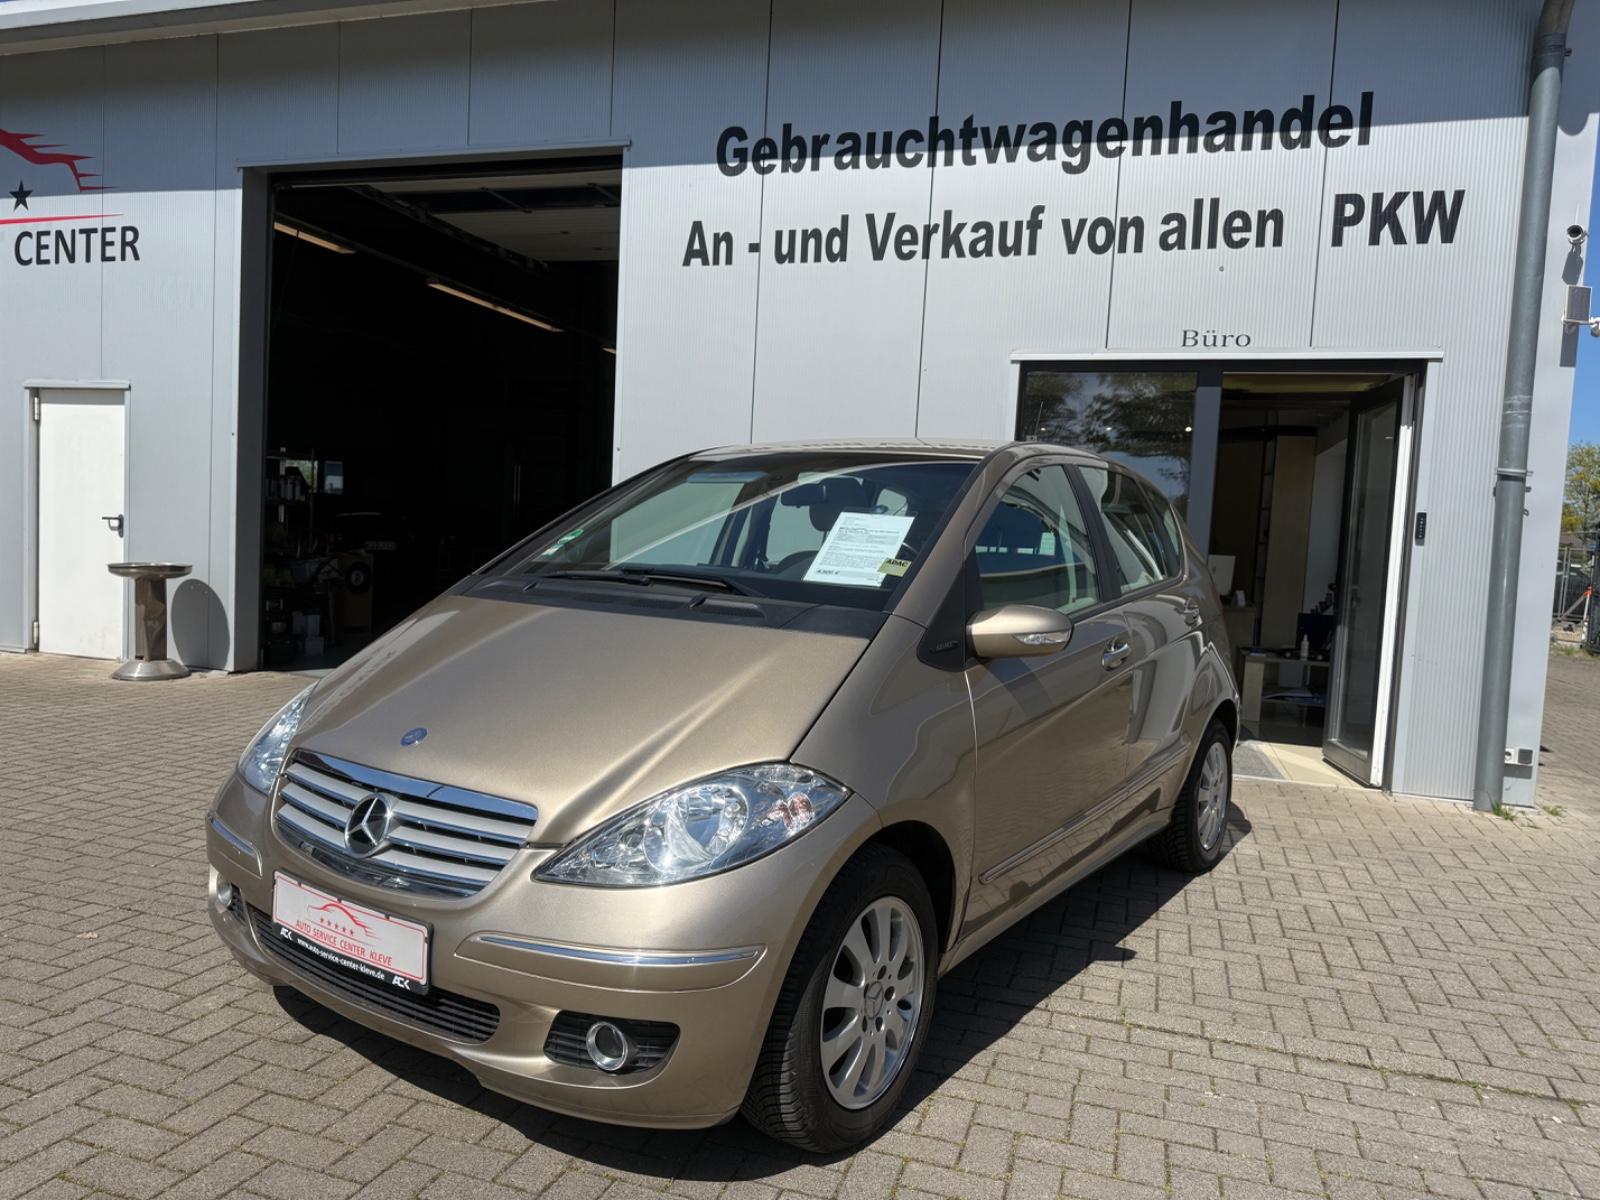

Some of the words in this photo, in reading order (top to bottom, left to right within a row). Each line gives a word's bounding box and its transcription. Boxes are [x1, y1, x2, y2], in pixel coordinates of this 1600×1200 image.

[716, 91, 1374, 177] Gebrauchtwagenhandel
[14, 226, 140, 266] CENTER
[682, 220, 734, 266] An
[774, 214, 849, 264] und
[865, 205, 1045, 261] Verkauf
[1061, 215, 1145, 255] von
[1158, 197, 1284, 252] allen
[1331, 189, 1466, 248] PKW
[1181, 329, 1252, 348] Büro
[295, 919, 311, 933] AUTO
[313, 929, 338, 947] SERVICE
[340, 940, 366, 957] CENTER
[369, 950, 393, 967] KLEVE
